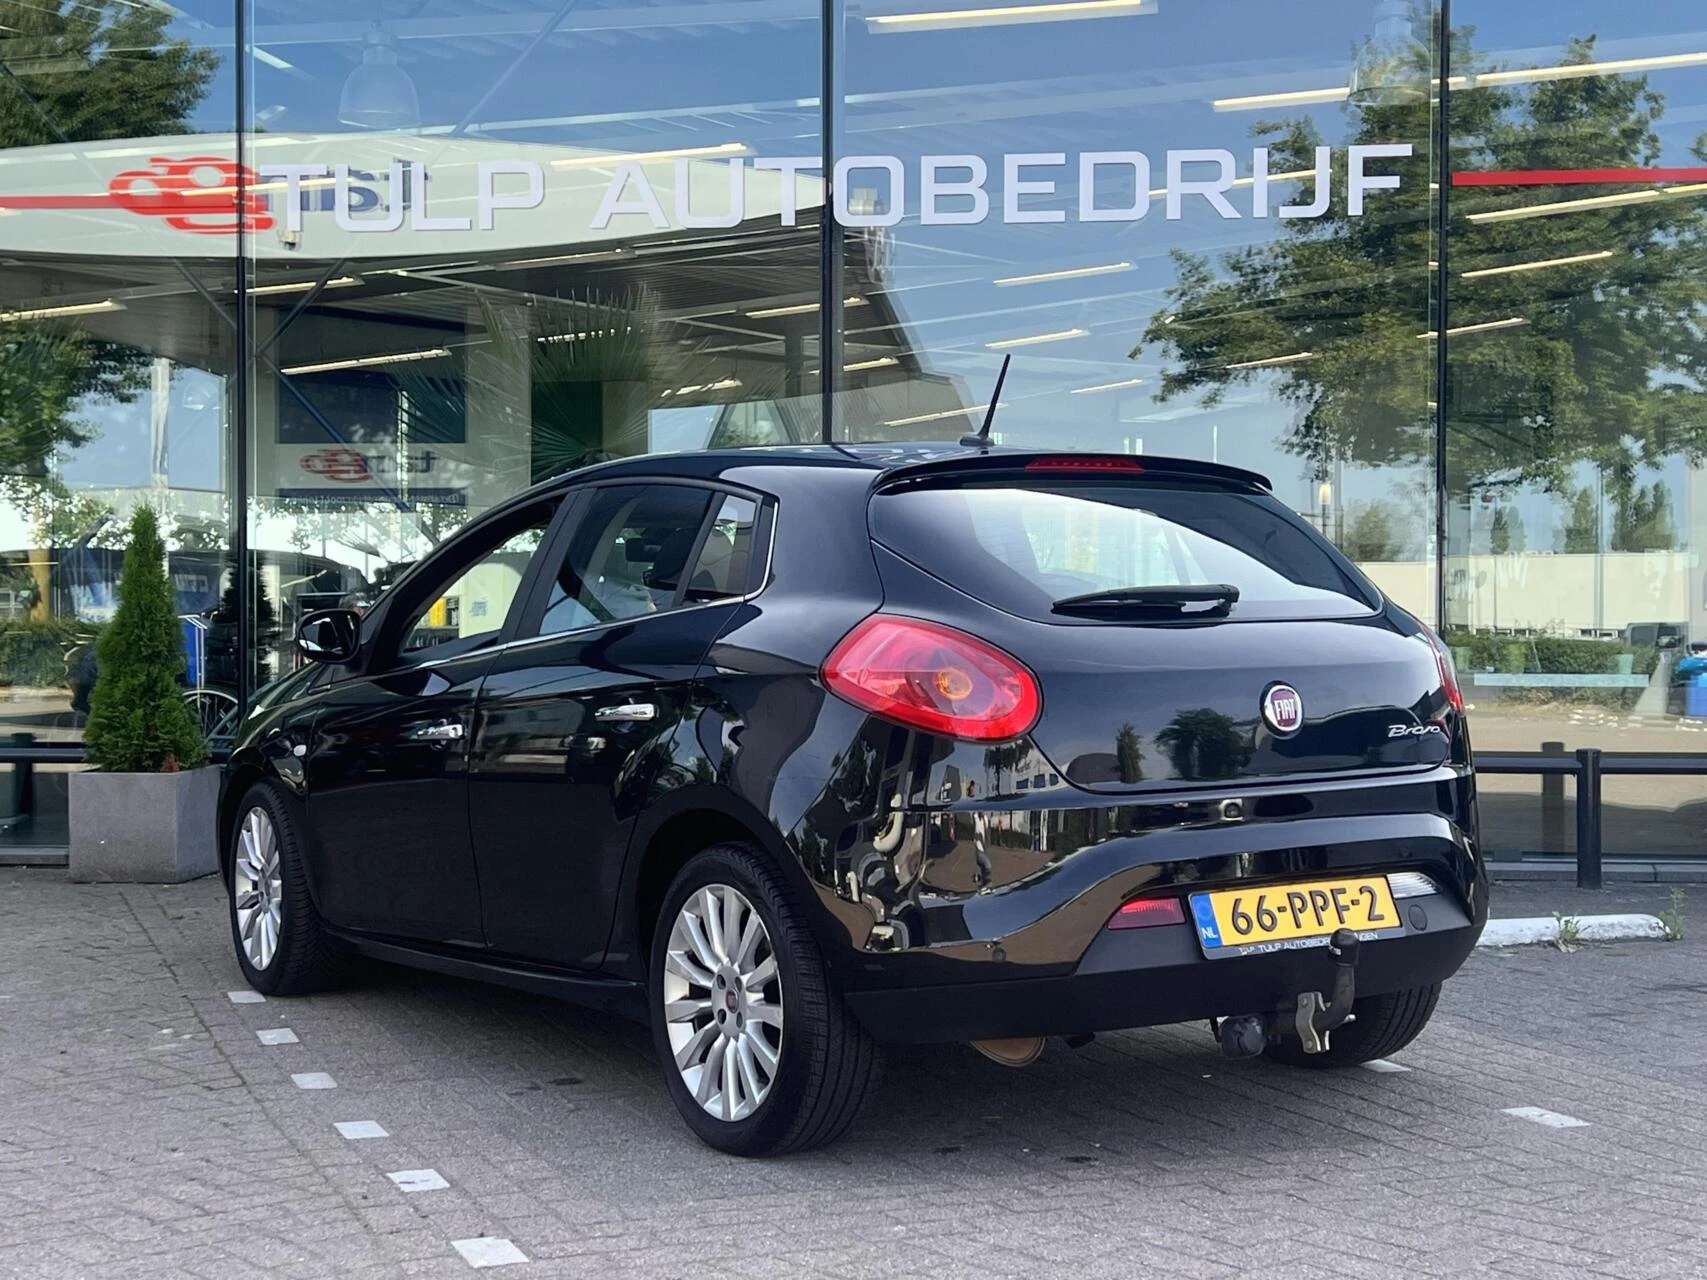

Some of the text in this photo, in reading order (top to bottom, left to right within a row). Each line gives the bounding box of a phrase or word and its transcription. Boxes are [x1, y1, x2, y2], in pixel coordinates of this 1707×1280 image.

[260, 160, 545, 233] TULP
[590, 143, 1413, 230] AUTOBEDRIJF
[1274, 699, 1297, 721] FIAT
[1388, 724, 1441, 738] Bravo
[1231, 885, 1385, 936] 66-PPF-2
[1201, 927, 1219, 940] NL
